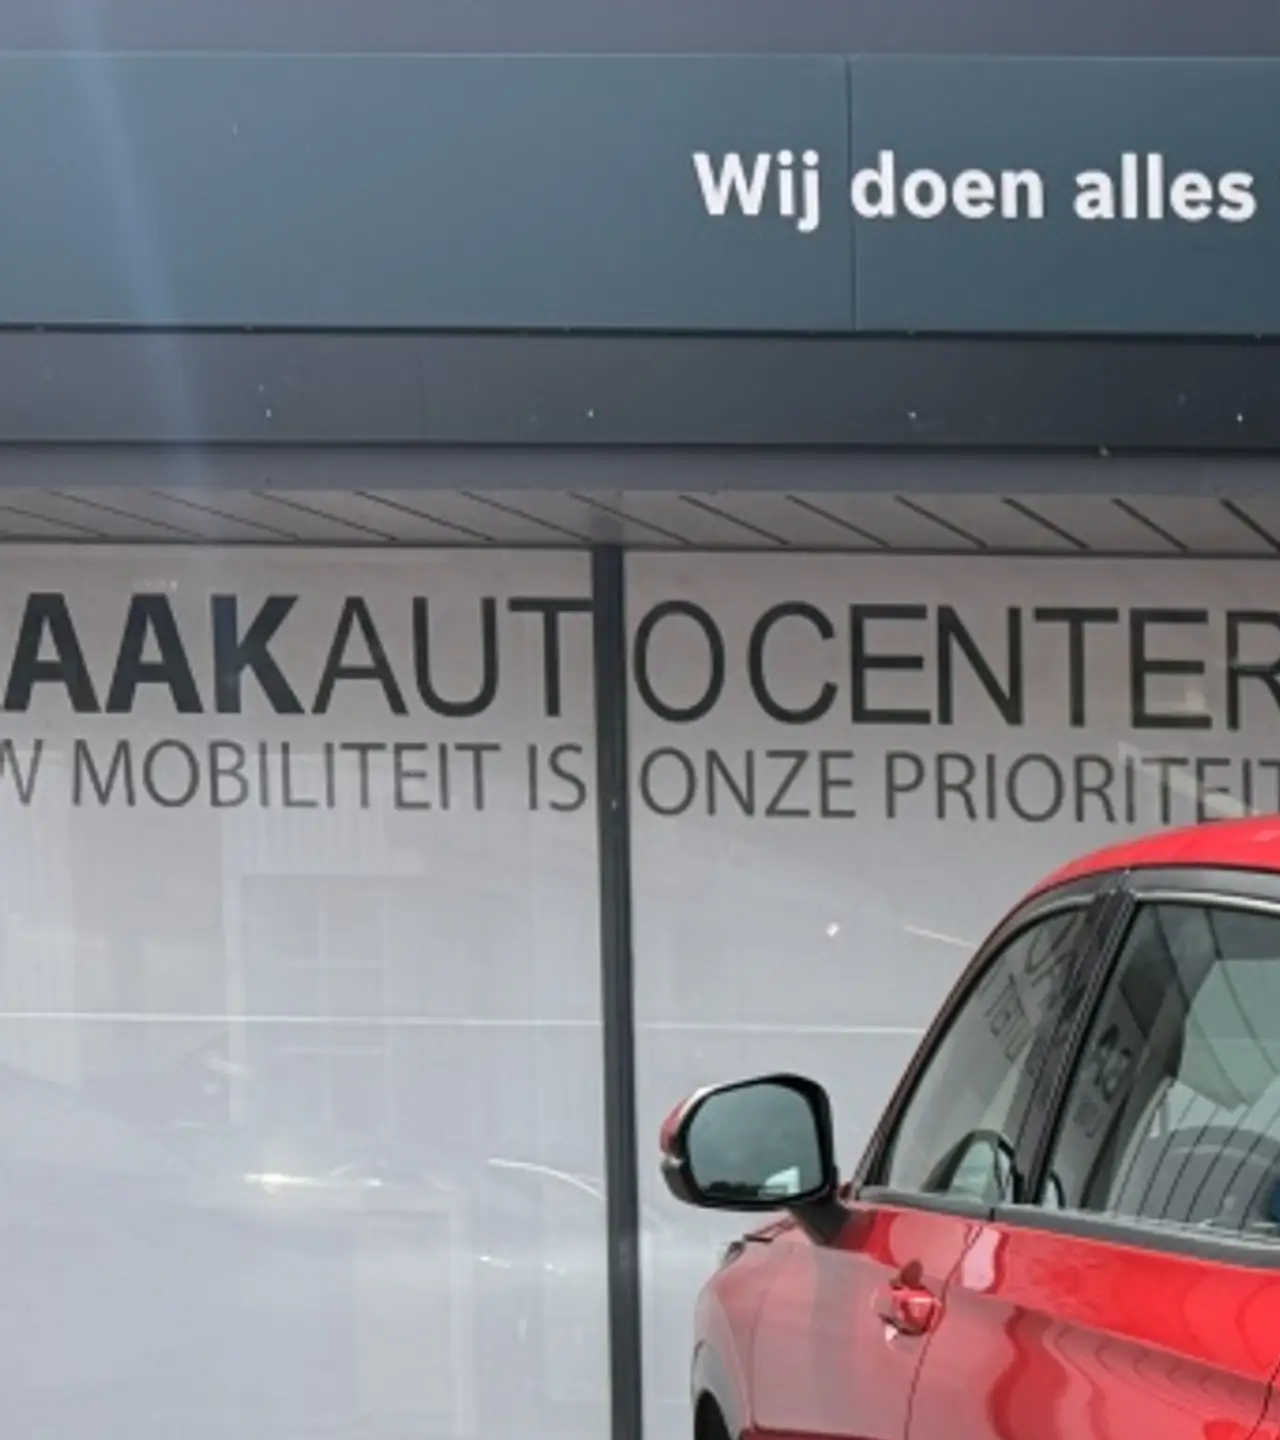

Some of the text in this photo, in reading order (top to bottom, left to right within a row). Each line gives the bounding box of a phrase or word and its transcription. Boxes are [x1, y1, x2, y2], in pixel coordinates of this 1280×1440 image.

[693, 150, 821, 233] Wij
[851, 150, 1045, 219] doen
[1074, 152, 1257, 221] alles
[72, 740, 501, 812] MOBILITEIT
[528, 745, 588, 813] IS
[639, 746, 857, 817] ONZE
